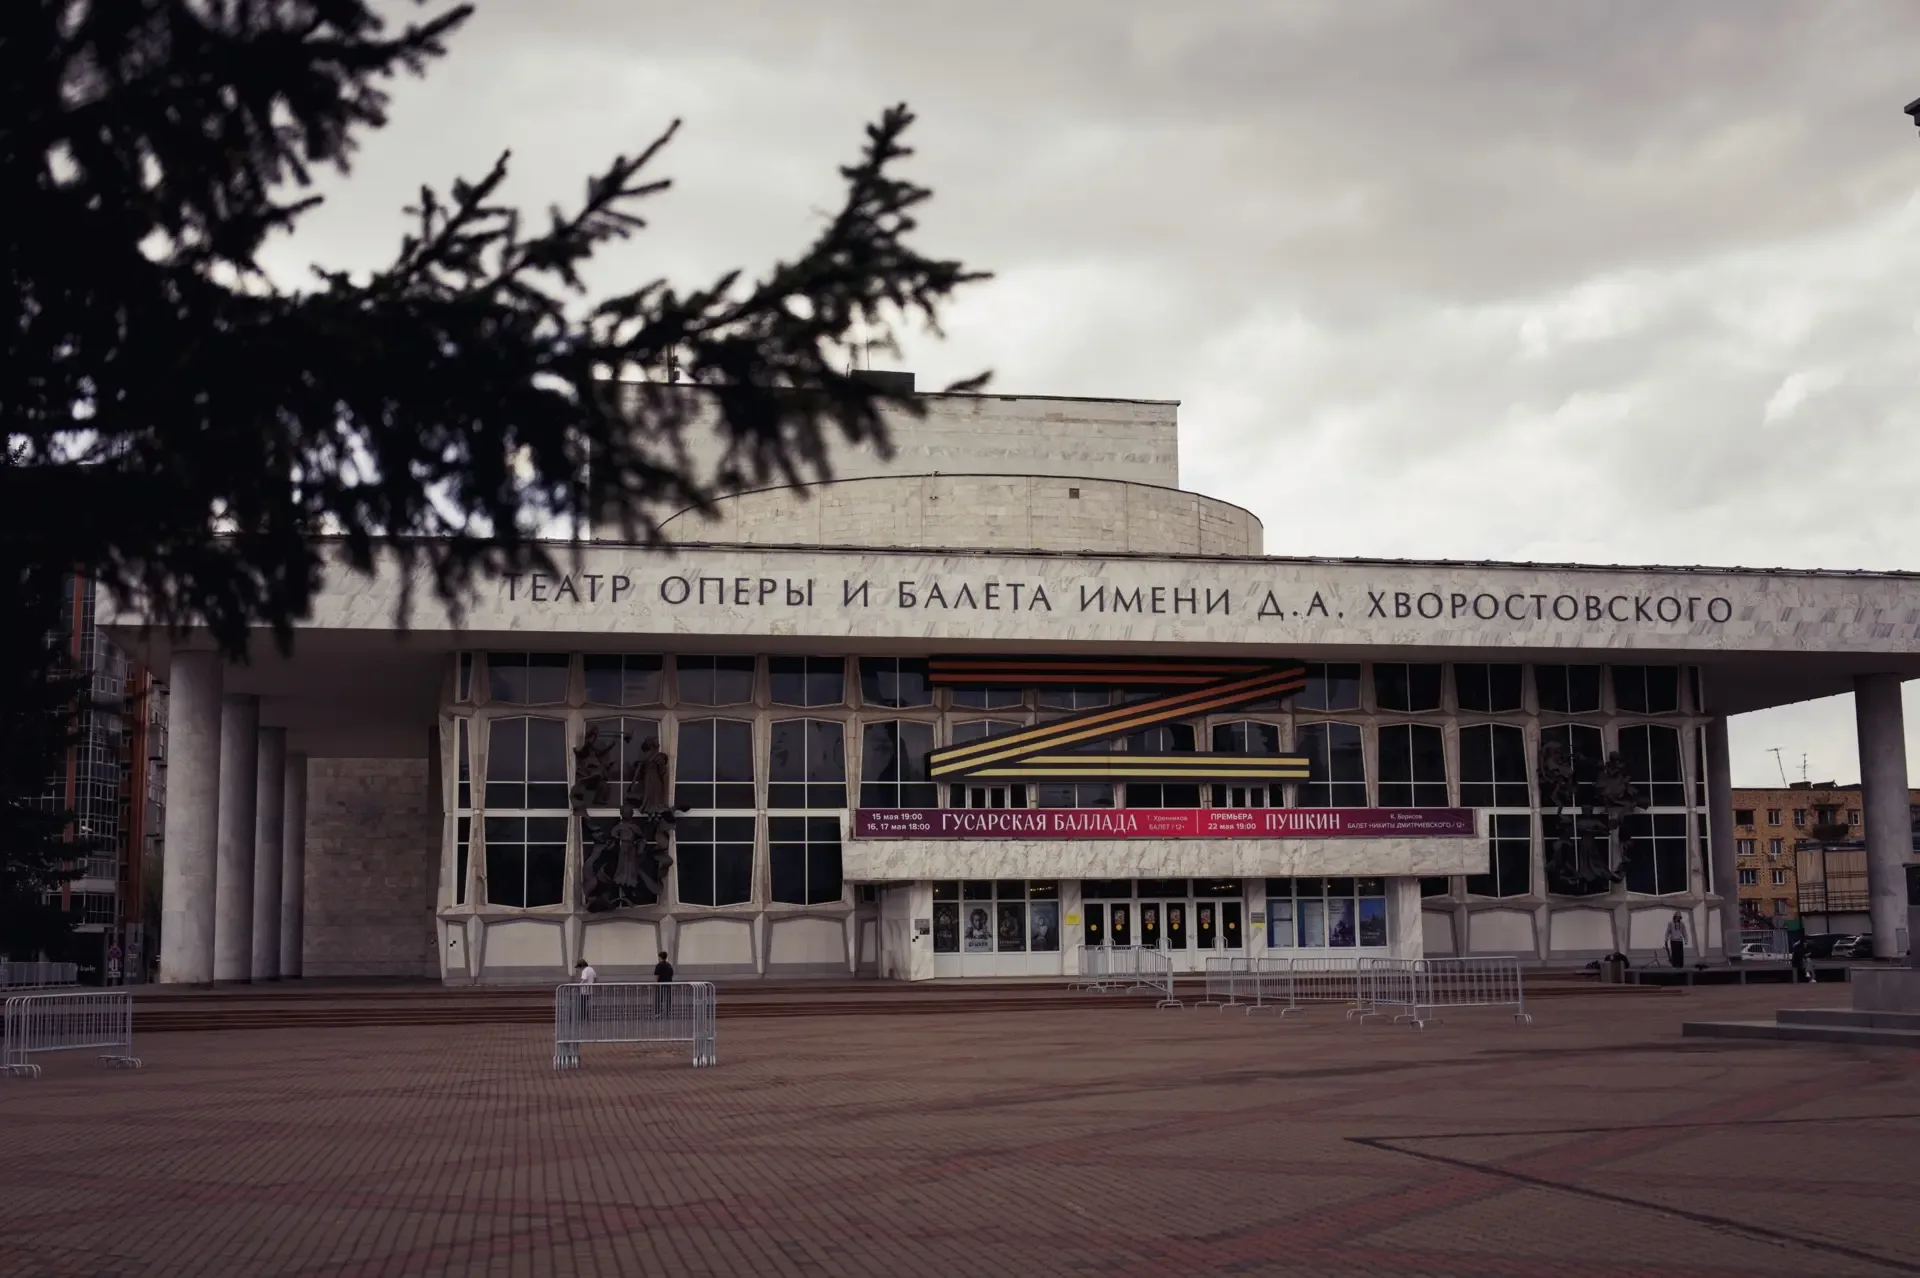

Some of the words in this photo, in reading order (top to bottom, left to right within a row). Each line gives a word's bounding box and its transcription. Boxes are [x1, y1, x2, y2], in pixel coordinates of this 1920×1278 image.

[502, 573, 631, 603] ТЕАТР
[660, 575, 814, 606] ОПЕРЫ
[843, 579, 870, 608] И
[898, 580, 1053, 611] БАЛЕТА
[1079, 585, 1231, 616] ИМЕНИ
[1256, 588, 1344, 620] Д.А.
[1366, 590, 1734, 624] ХВОРОСТОВСКОГО
[871, 813, 882, 821] 15
[900, 813, 923, 821] 19:00
[1210, 812, 1253, 821] ПРЕМЬЕРА
[1397, 813, 1423, 821] Борисов
[942, 813, 1047, 831] ГУСАРСКАЯ
[1054, 813, 1139, 834] БАЛЛАДА
[1265, 813, 1340, 830] ПУШКИН
[1396, 821, 1451, 829] ДМИТРИЕВСКОГО
[867, 823, 879, 831] 16,
[880, 823, 889, 831] 17
[908, 823, 931, 831] 18:00
[1148, 823, 1170, 831] БАЛЕТ
[1207, 822, 1218, 830] 22
[1236, 822, 1257, 830] 19:00
